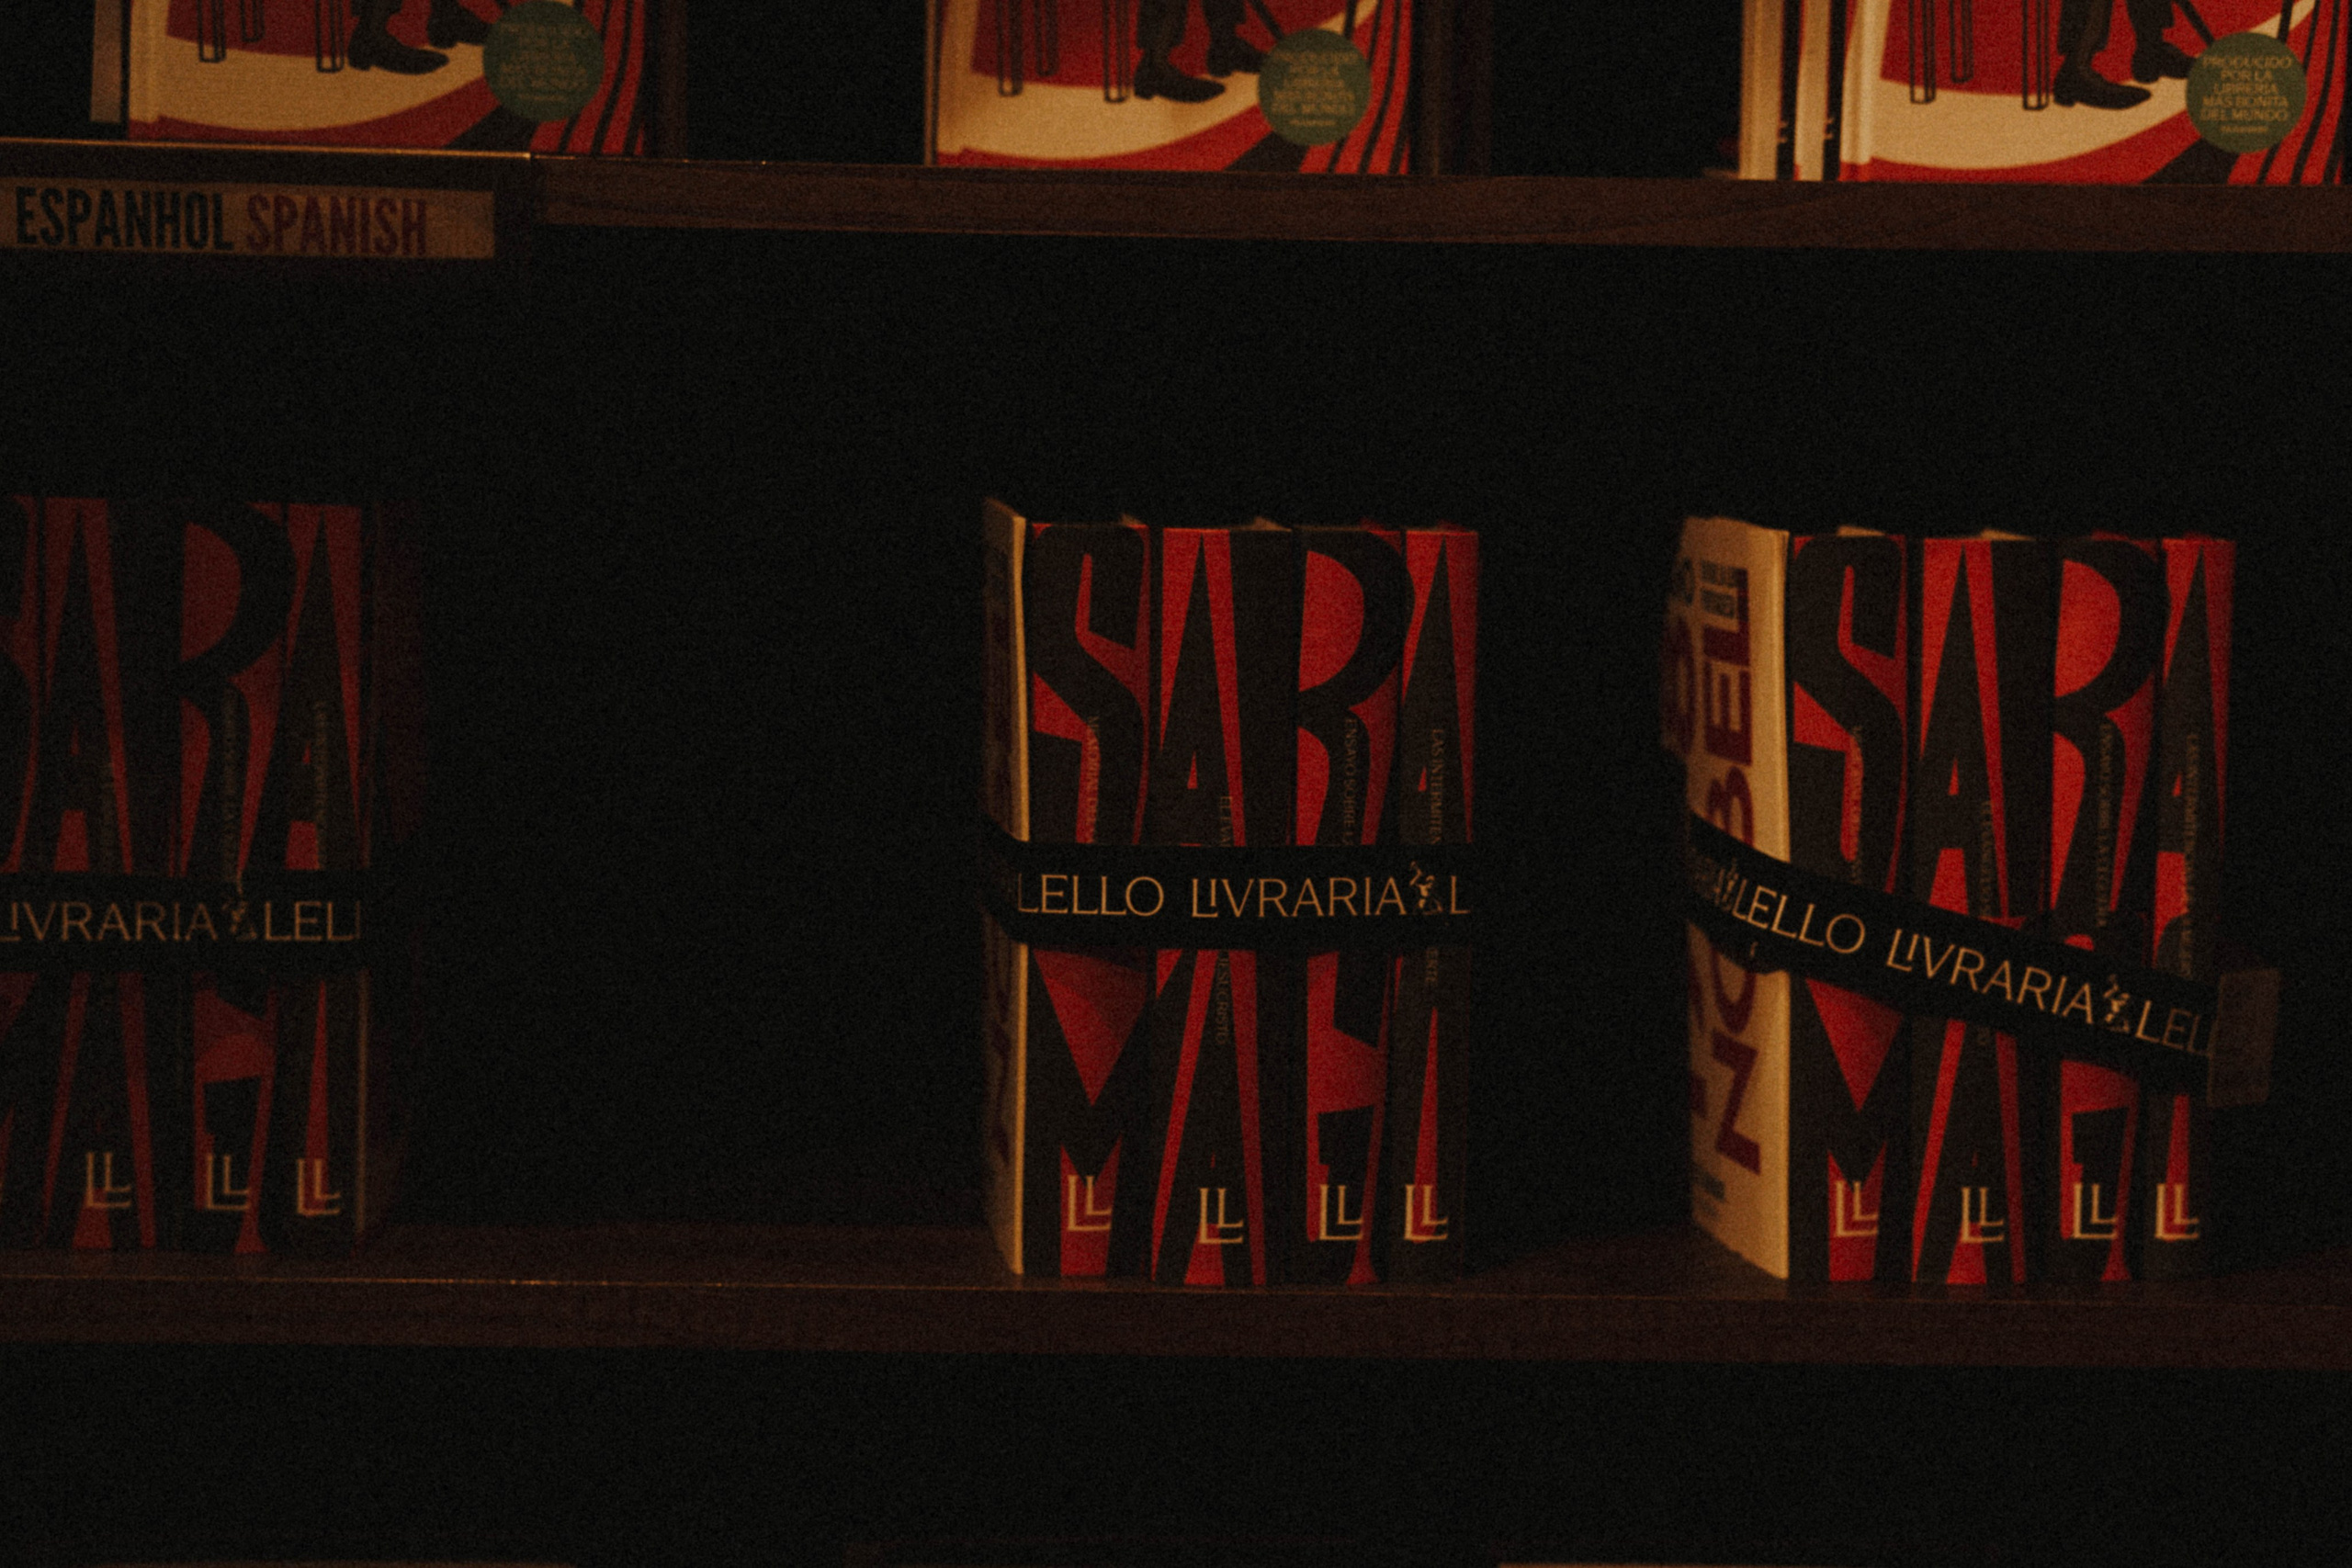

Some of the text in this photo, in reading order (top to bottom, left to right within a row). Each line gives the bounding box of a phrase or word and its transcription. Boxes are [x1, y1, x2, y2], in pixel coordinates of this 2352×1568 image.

[2221, 69, 2274, 82] POR LA
[2200, 108, 2289, 121] DEL MUNDO
[15, 186, 427, 255] ESPANHOL SPANISH
[1027, 525, 1477, 847] SARA
[1790, 533, 2237, 951] SARA
[1017, 874, 1164, 918] LELLO
[1191, 876, 1408, 919] LIVRARIA
[1731, 878, 1867, 954] LELLO
[1885, 928, 2094, 1024] LIVRARIA
